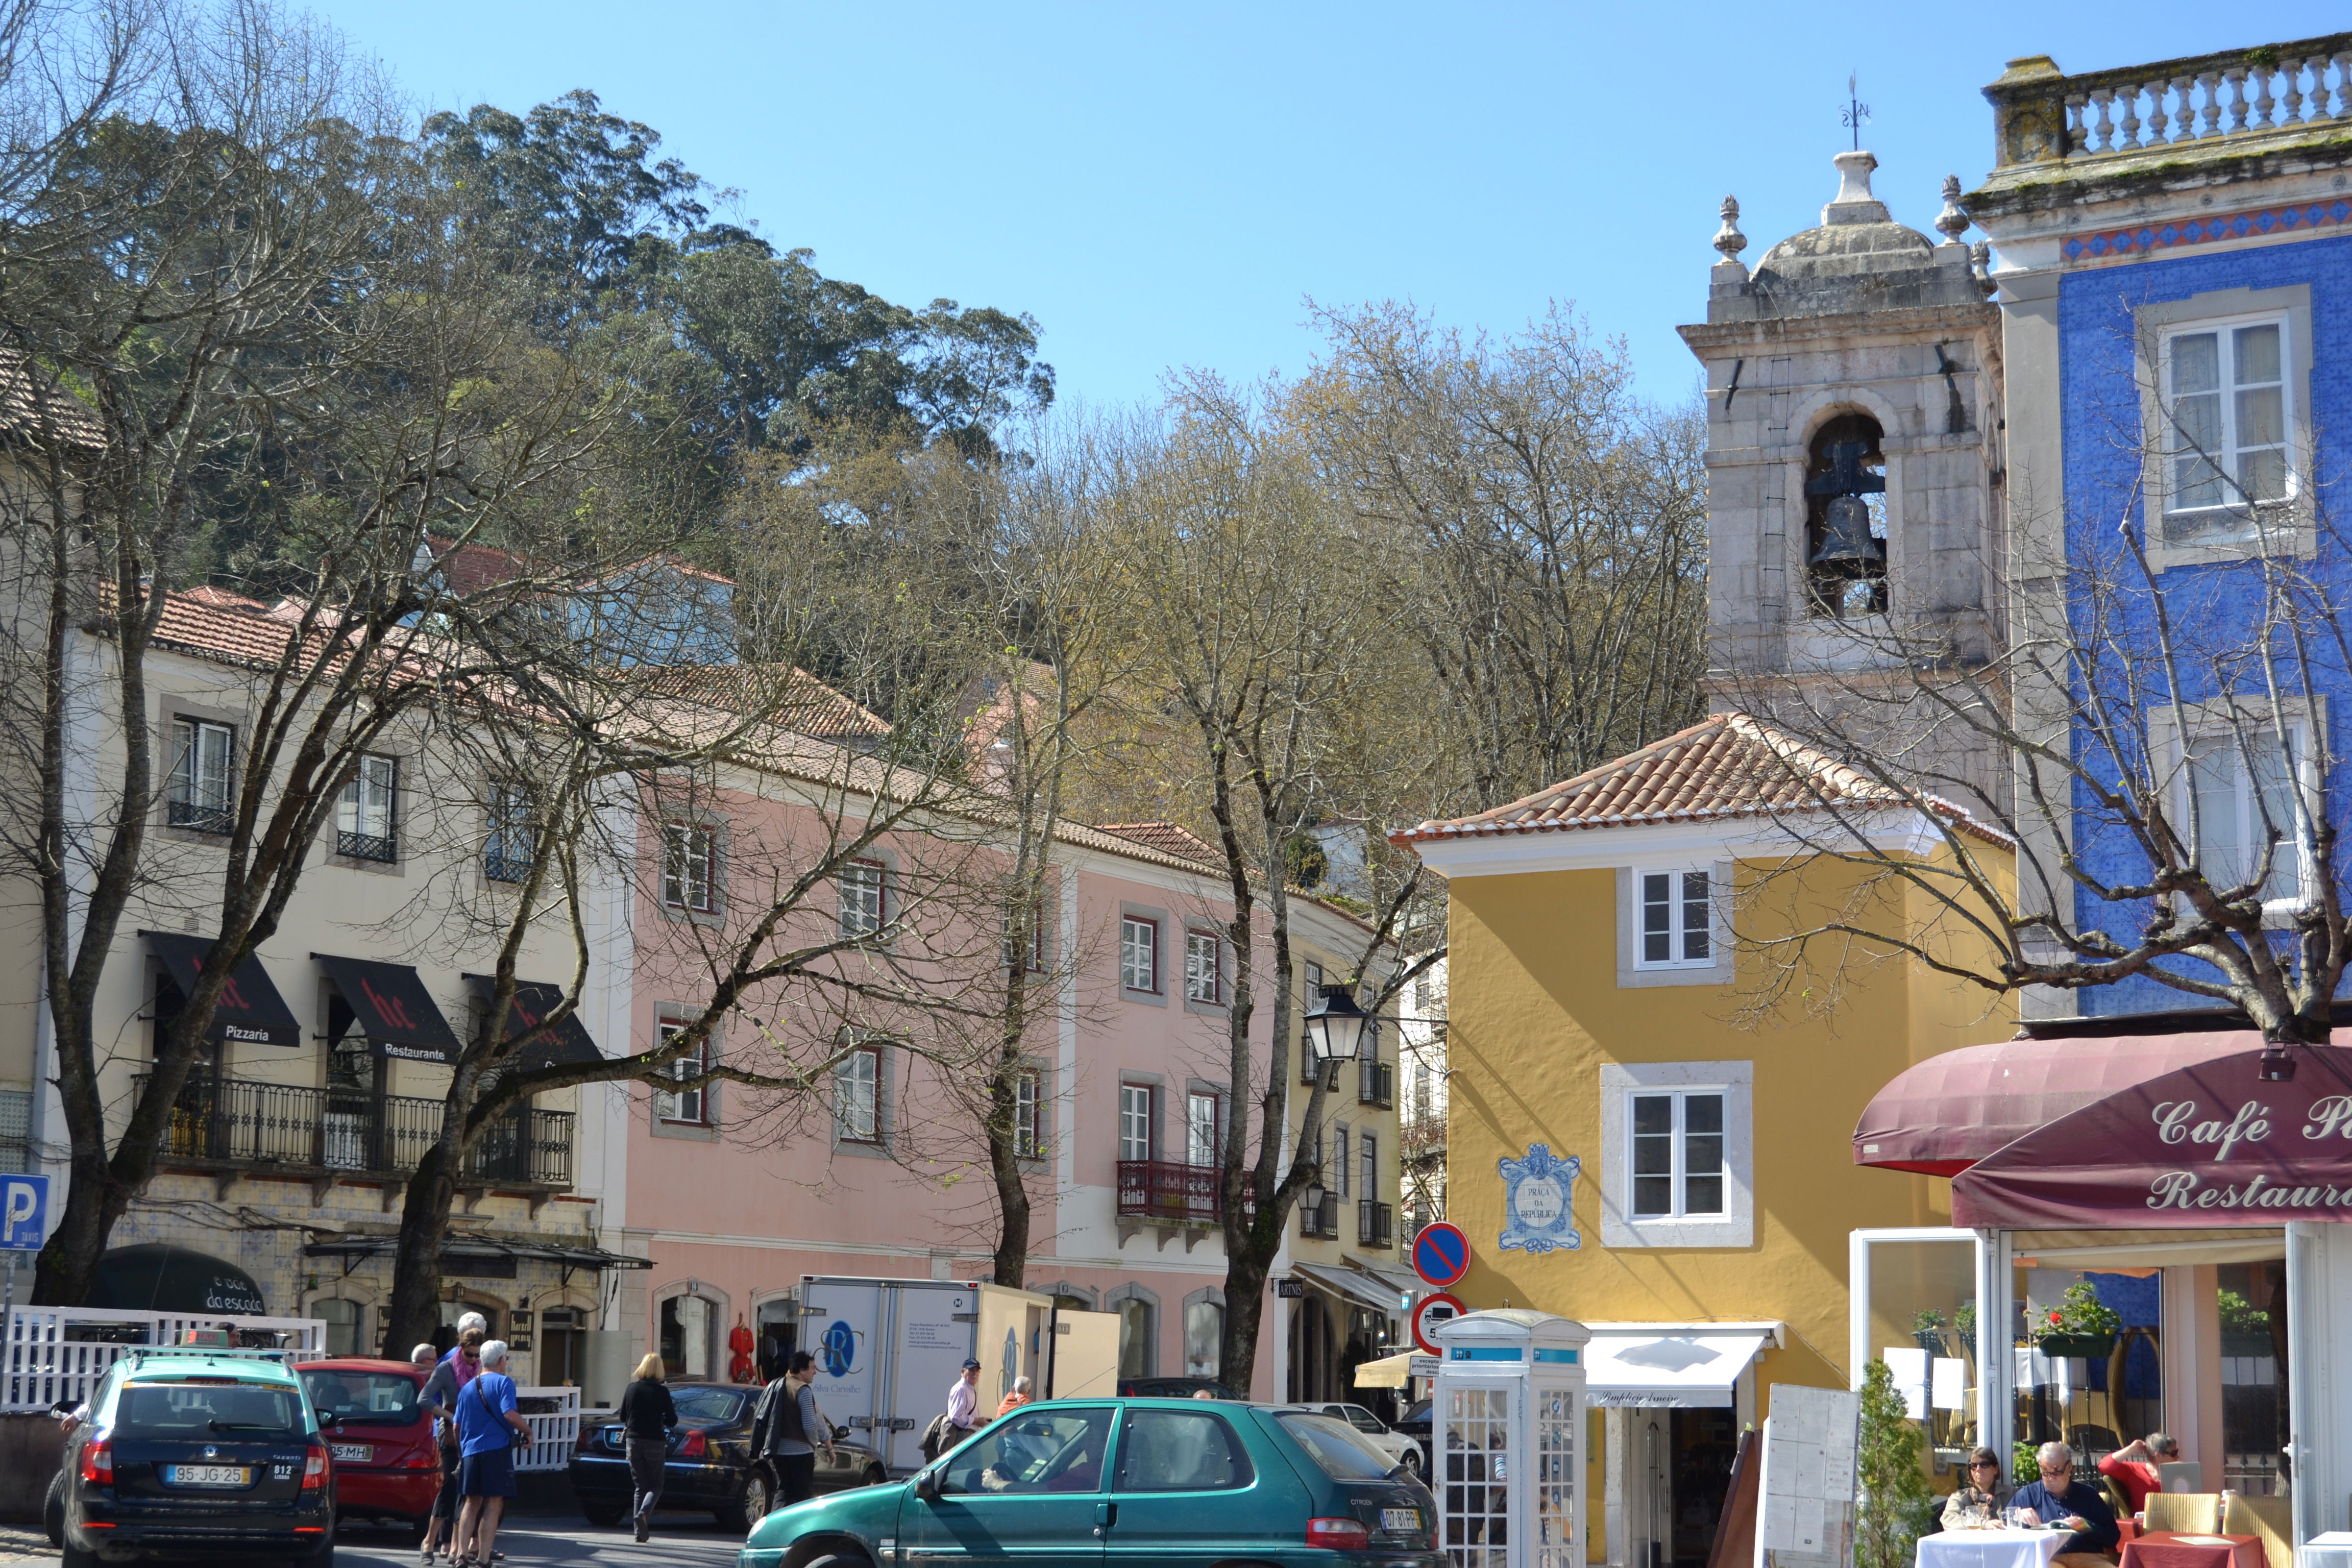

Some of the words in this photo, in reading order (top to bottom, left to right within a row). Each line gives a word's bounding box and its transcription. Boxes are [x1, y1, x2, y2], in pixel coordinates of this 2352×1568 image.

[226, 1025, 269, 1041] Pizzaria
[385, 1043, 445, 1060] Restaurante
[2151, 1100, 2271, 1161] Café
[1528, 1188, 1550, 1197] PRAÇA
[4, 1182, 37, 1242] P
[1521, 1208, 1556, 1218] REPÚBLICA
[21, 1232, 39, 1242] TAXIS
[1279, 1283, 1302, 1295] ARTNIS
[207, 1288, 223, 1308] da
[225, 1292, 263, 1312] escada
[830, 1384, 861, 1393] Carvalho
[274, 1465, 292, 1475] 812
